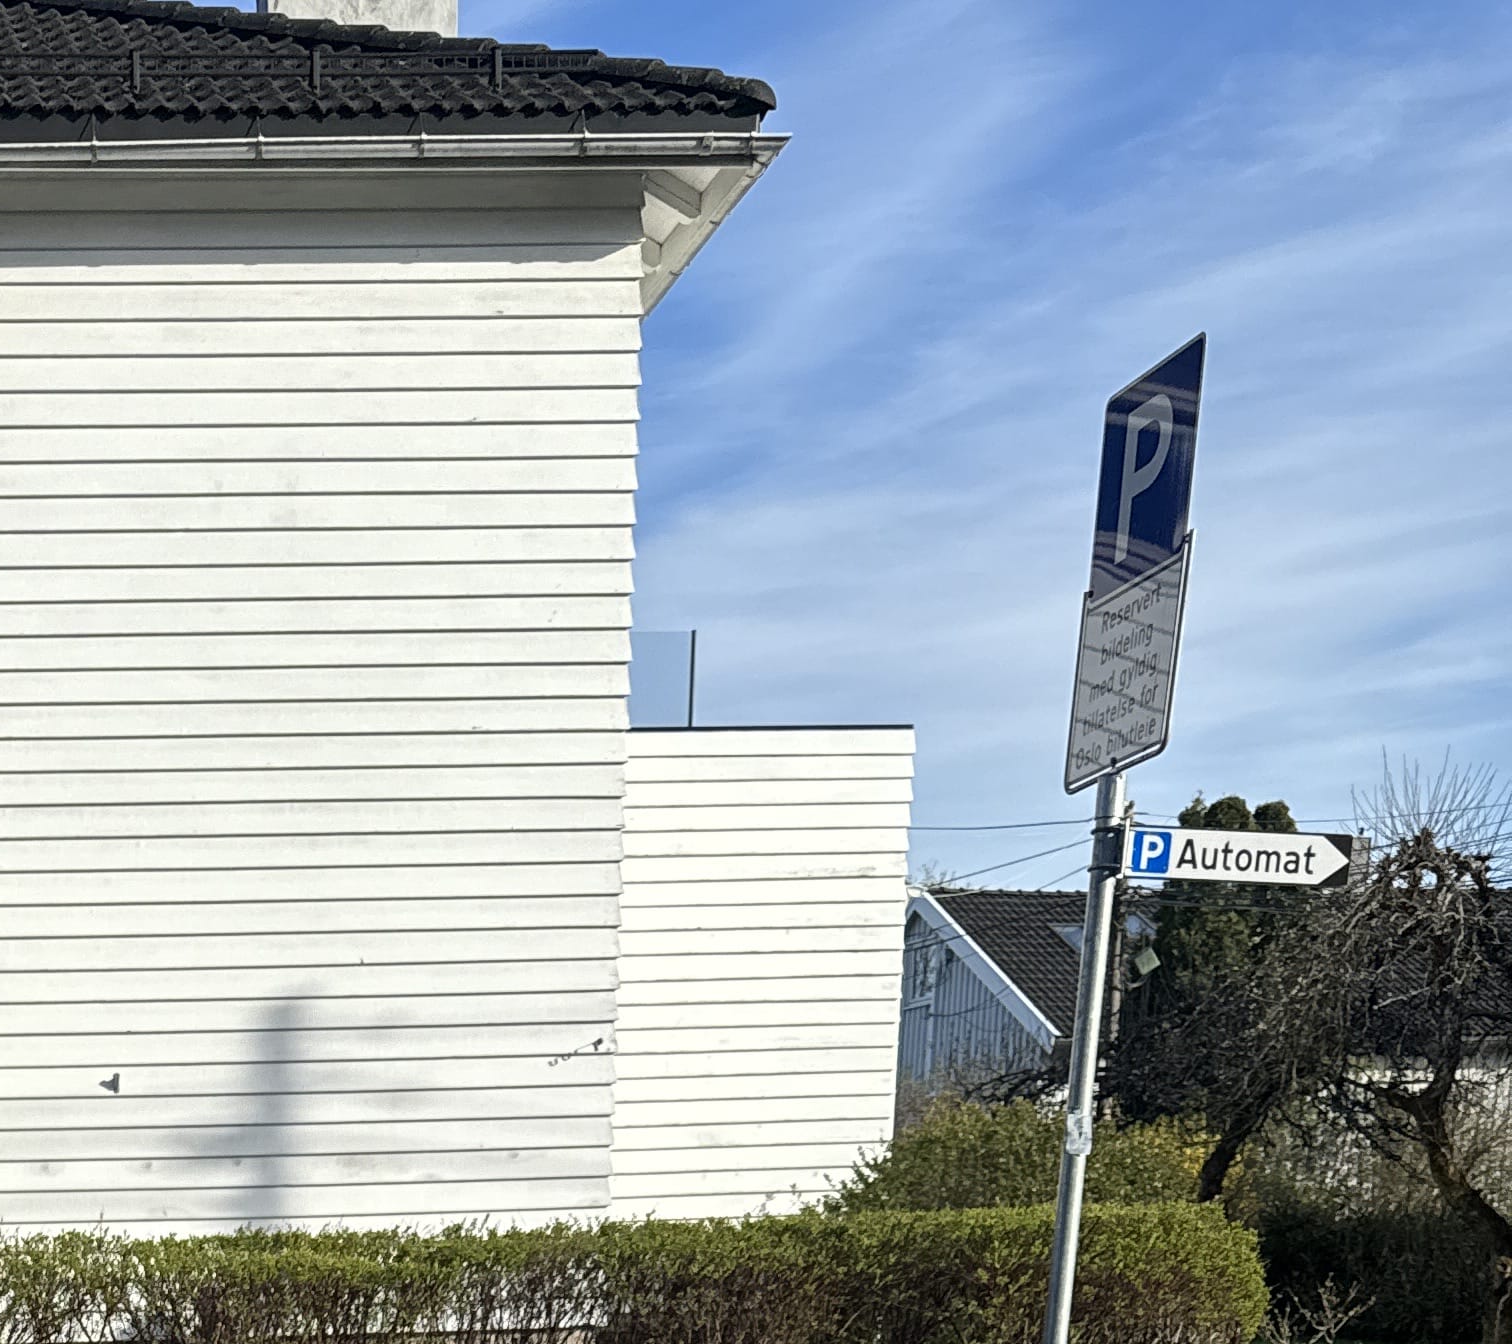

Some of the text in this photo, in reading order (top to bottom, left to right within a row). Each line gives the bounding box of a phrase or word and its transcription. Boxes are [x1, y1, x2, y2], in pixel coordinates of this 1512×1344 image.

[1115, 394, 1174, 565] P
[1100, 583, 1161, 634] Reservert
[1100, 623, 1154, 666] bildeling
[1089, 652, 1157, 703] med gyldig
[1083, 684, 1159, 737] tillatelse for
[1075, 717, 1156, 770] Oslo bilutleie
[1139, 834, 1317, 875] P Automat
